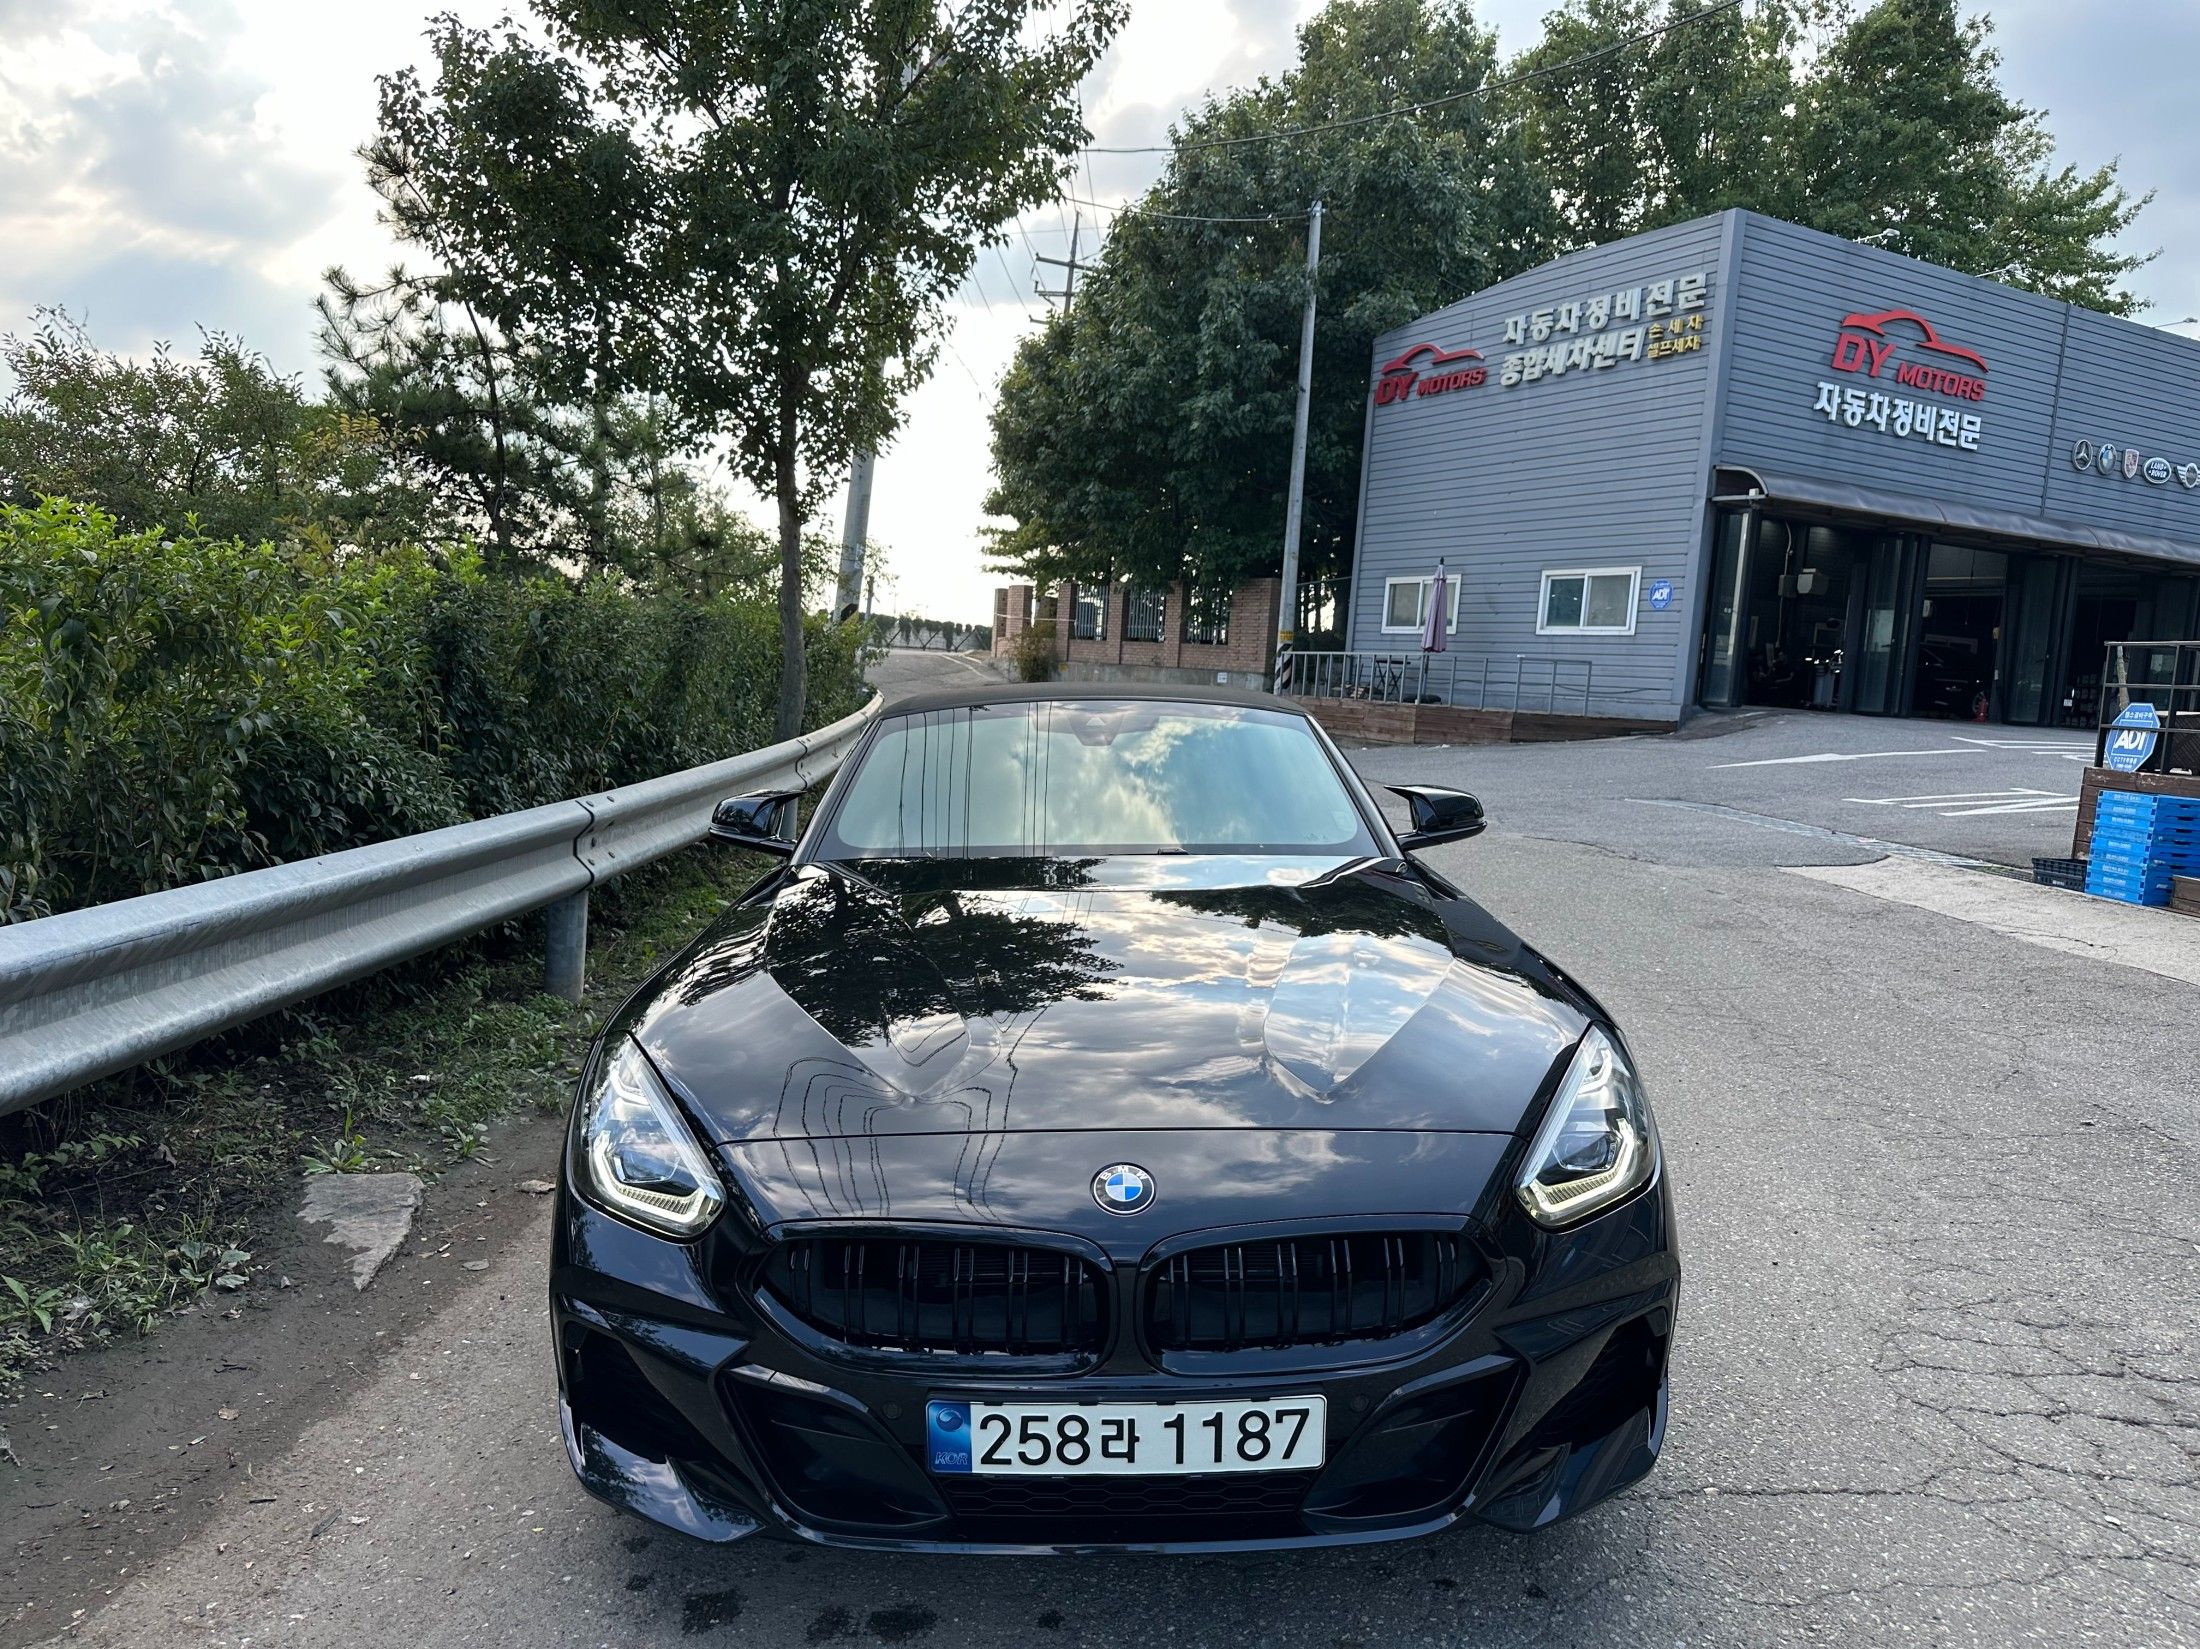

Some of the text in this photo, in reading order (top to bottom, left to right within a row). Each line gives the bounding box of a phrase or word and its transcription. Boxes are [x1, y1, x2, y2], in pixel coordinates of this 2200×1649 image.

[1502, 272, 1707, 345] 자동차정비전문
[1500, 326, 1647, 387] 종합세차센터
[1647, 334, 1702, 359] 셀프세차
[1831, 332, 1987, 401] DY MOTORS
[1375, 367, 1488, 405] DY MOTORS
[1813, 381, 1982, 451] 자동차정비전문
[2150, 462, 2164, 471] LAND
[2150, 470, 2167, 478] ROVER
[1651, 587, 1670, 601] ADT
[1099, 1166, 1150, 1181] BMW
[979, 1407, 1311, 1466] 258라 1187
[934, 1451, 969, 1466] KOR
